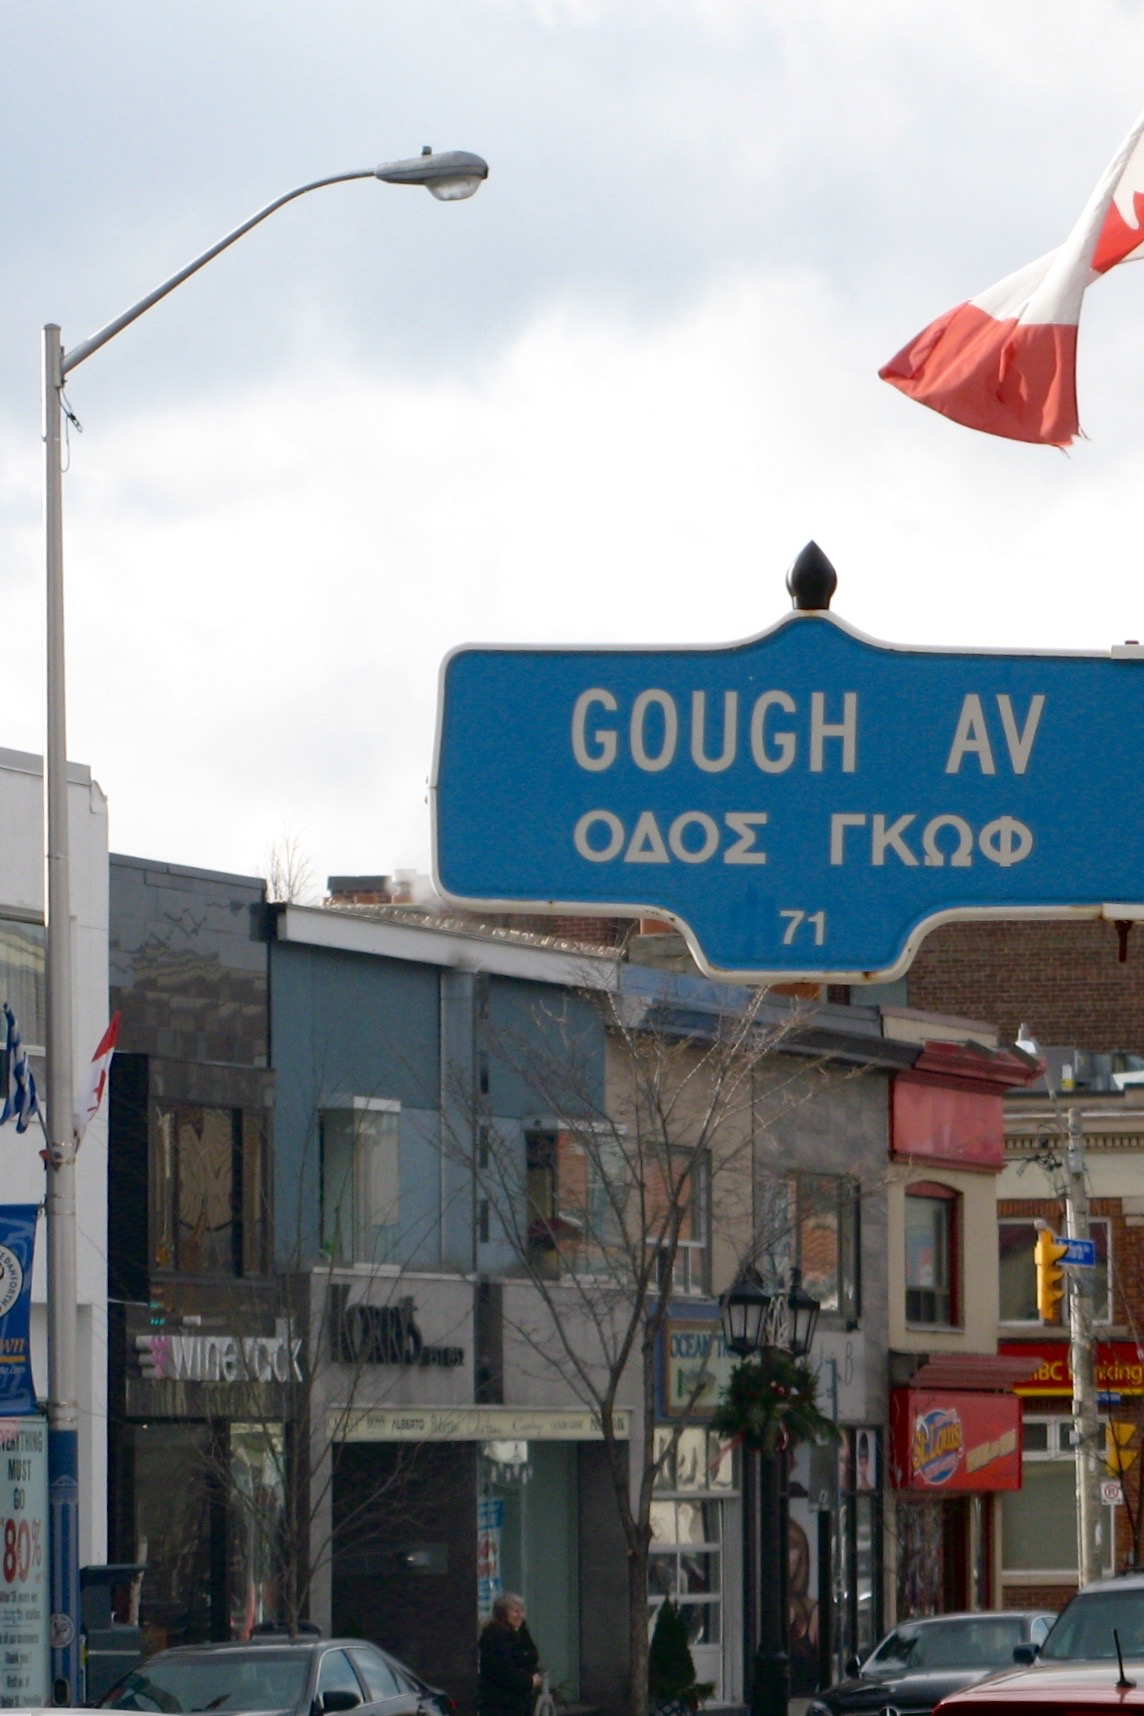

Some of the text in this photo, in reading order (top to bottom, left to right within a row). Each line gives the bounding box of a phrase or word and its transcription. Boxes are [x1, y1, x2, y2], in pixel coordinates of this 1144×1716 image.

[571, 688, 1046, 776] GOUGH AV
[573, 809, 1034, 868] ΟΔΟΣ ΓΚΩΦ
[779, 908, 826, 947] 71
[8, 1458, 31, 1481] MUST
[13, 1487, 26, 1510] GO
